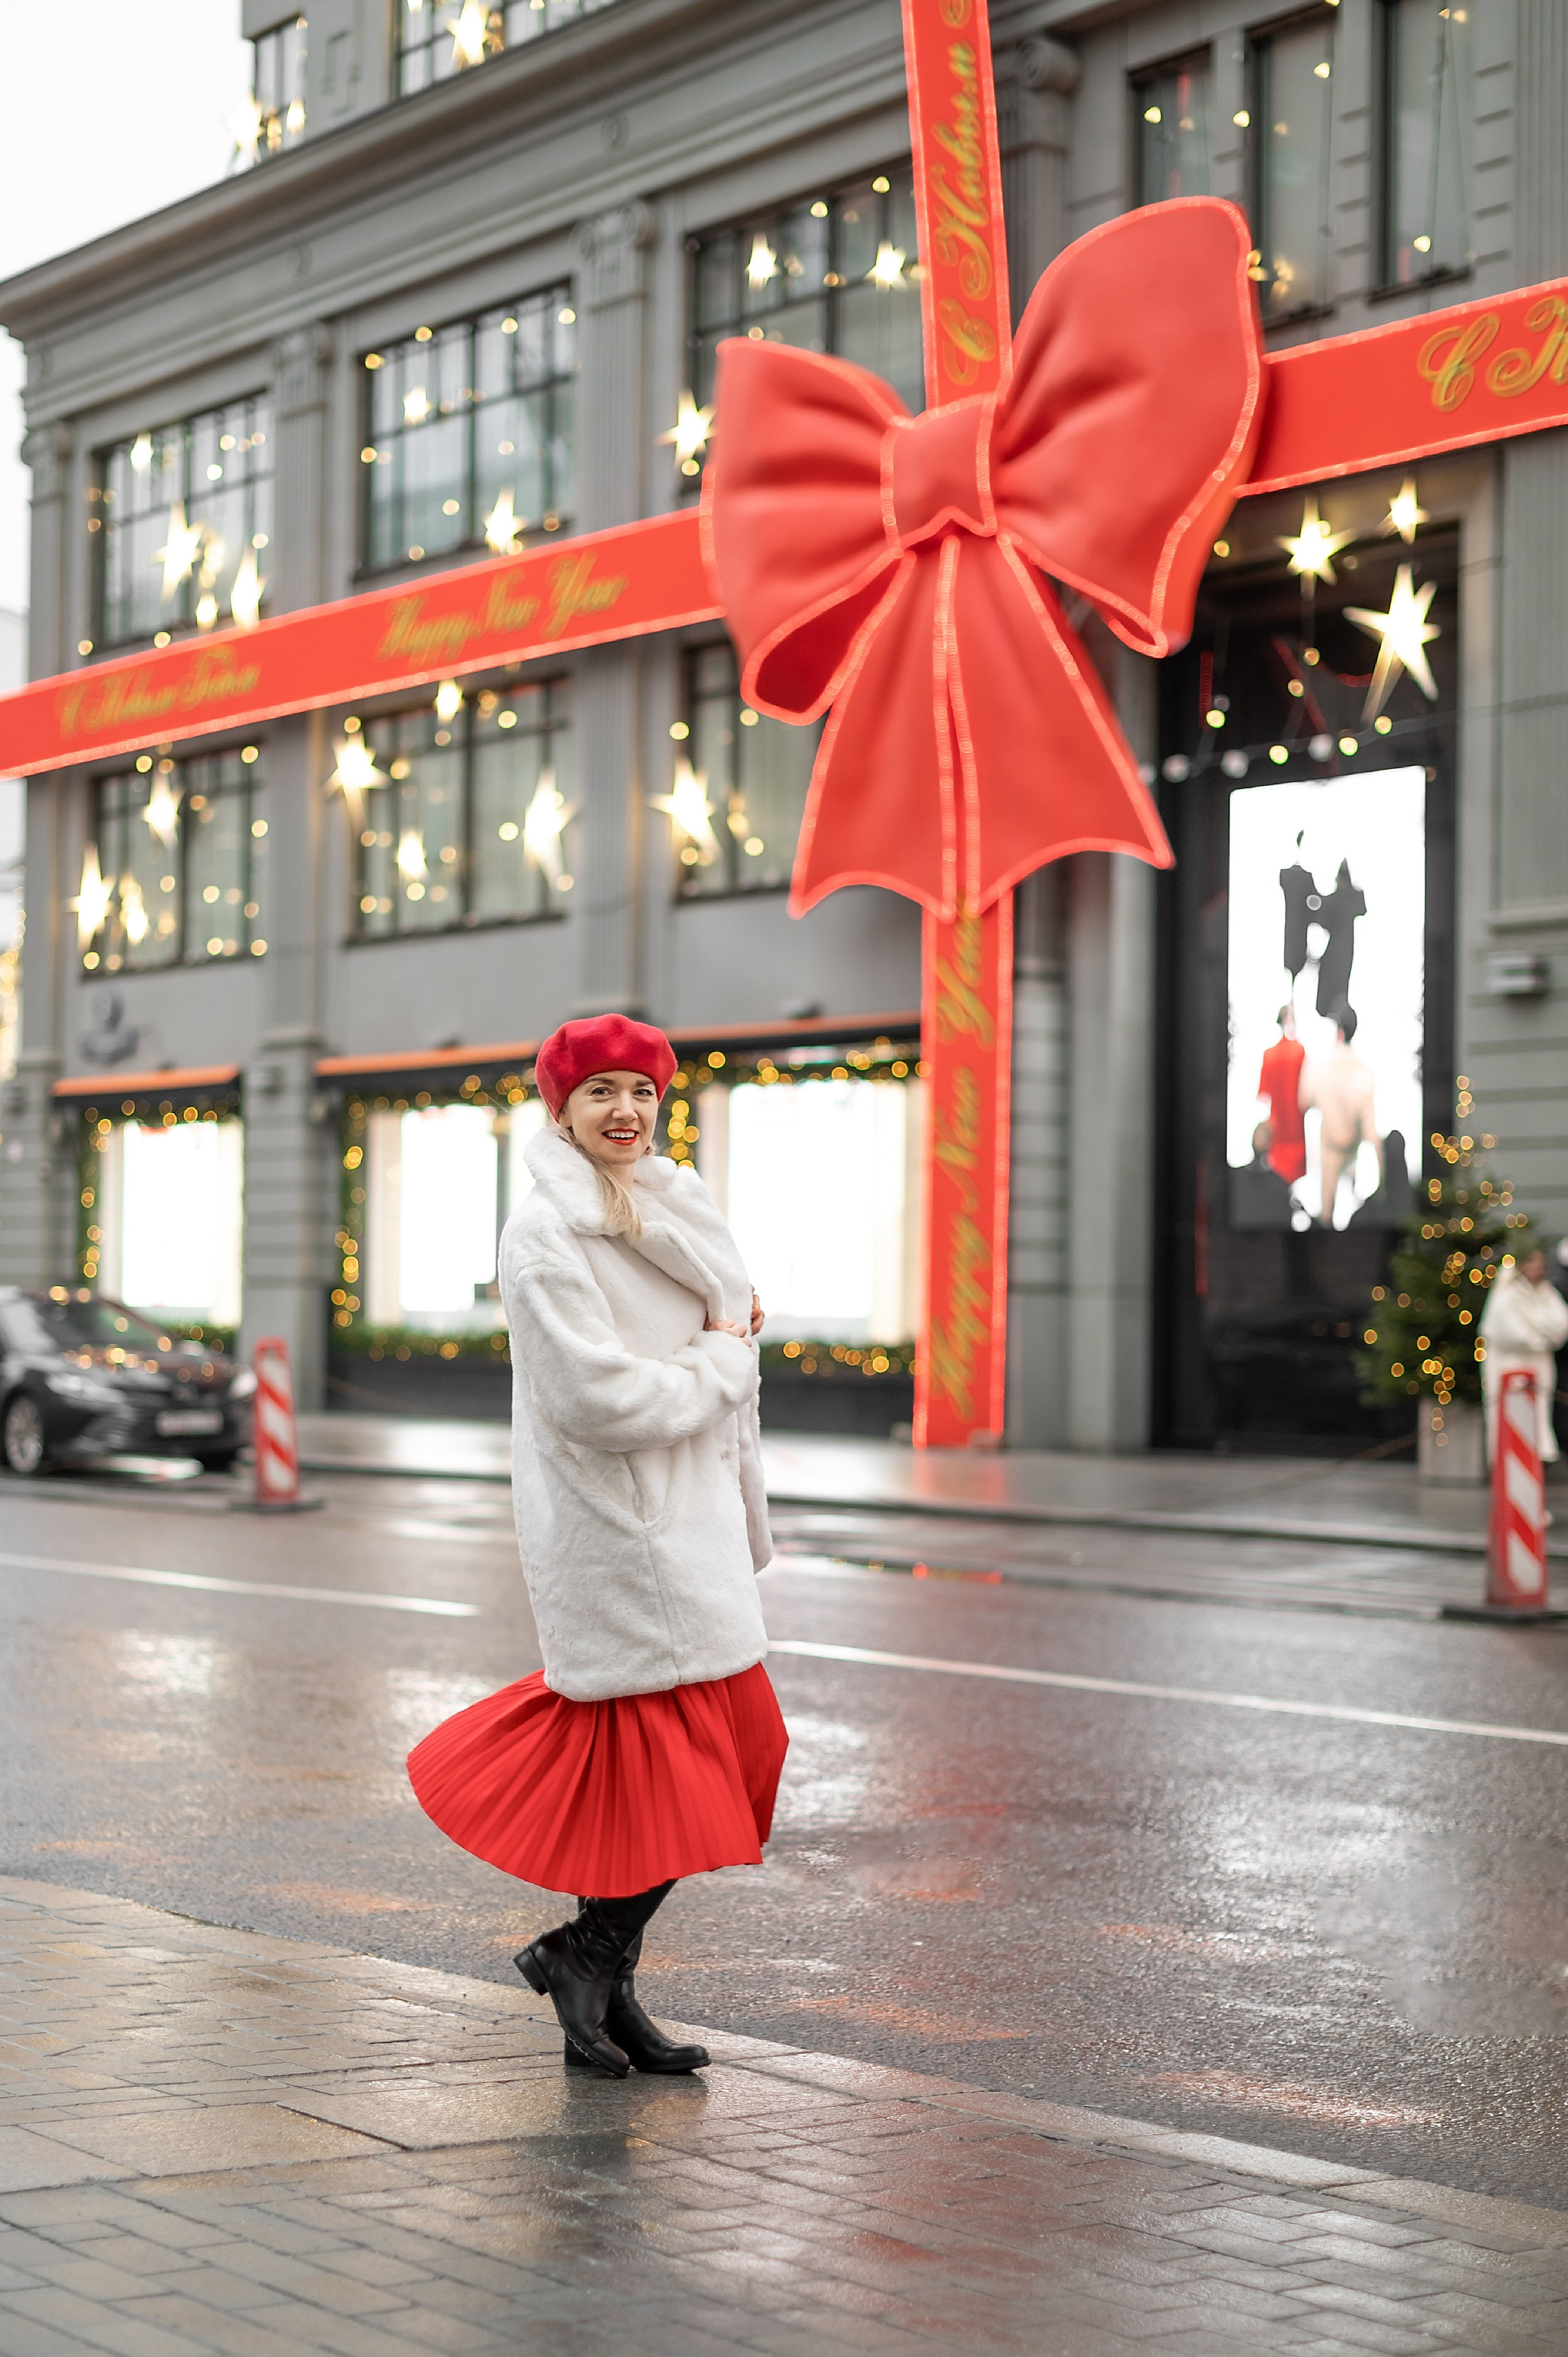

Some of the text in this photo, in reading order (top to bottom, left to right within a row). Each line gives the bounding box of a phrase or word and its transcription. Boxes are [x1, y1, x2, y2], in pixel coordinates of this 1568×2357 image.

[375, 549, 630, 670] Happy New Year
[933, 1065, 983, 1216] New
[929, 1210, 992, 1424] Happy
